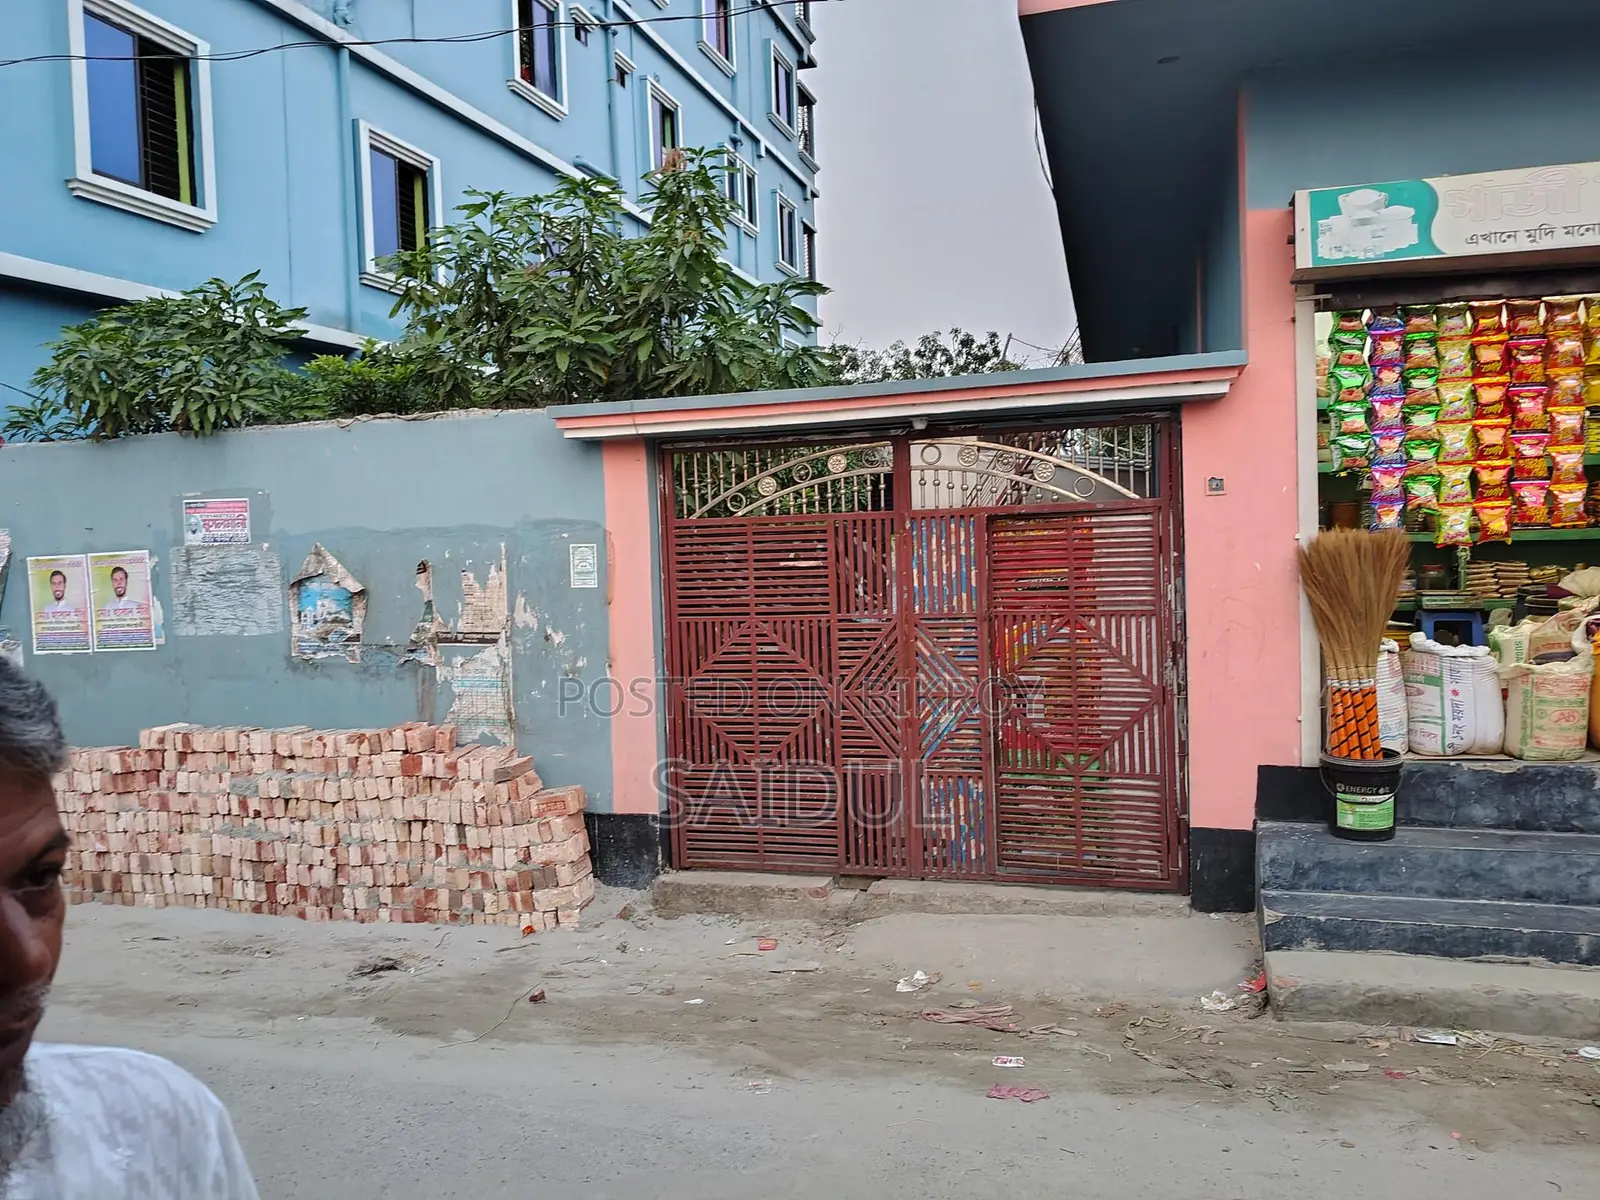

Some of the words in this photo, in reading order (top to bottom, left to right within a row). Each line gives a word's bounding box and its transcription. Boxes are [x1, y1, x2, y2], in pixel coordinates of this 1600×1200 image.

[1465, 230, 1520, 246] এখানে
[1524, 223, 1557, 245] মুদি
[1345, 785, 1378, 794] ENERGY
